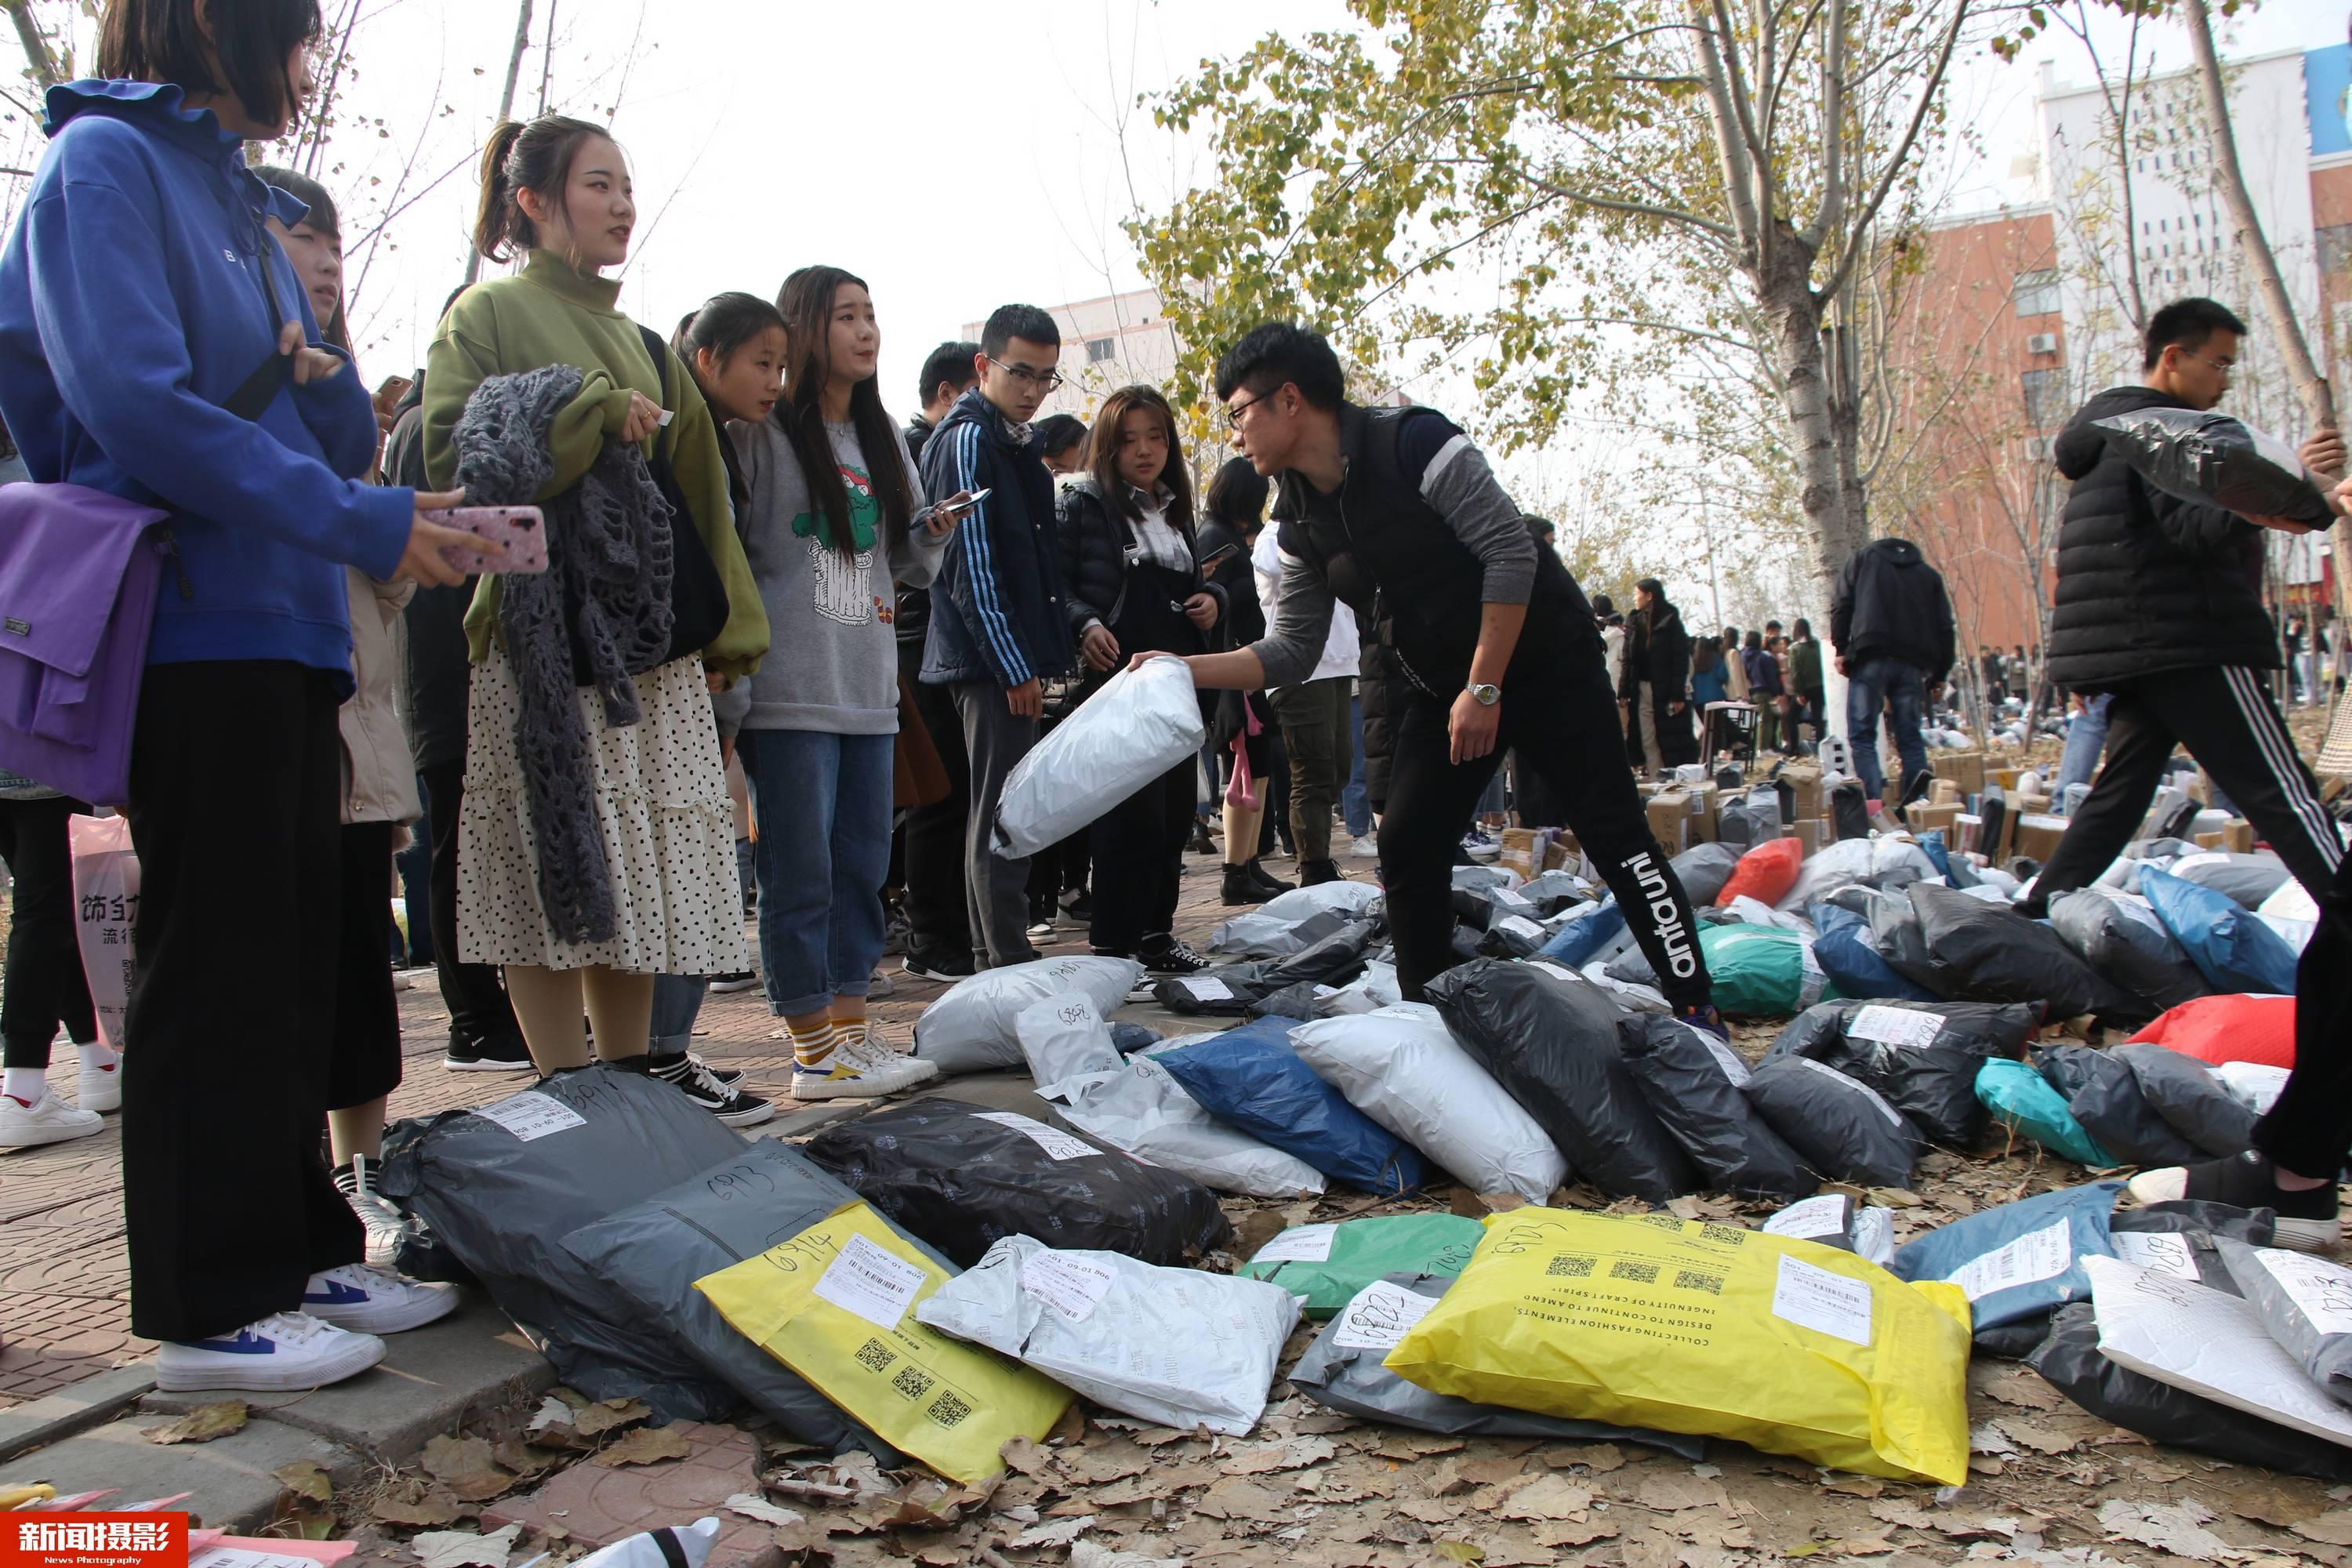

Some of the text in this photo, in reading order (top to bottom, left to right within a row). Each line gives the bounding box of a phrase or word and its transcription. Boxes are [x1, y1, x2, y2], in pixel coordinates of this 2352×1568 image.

[1620, 851, 1697, 979] antauni
[707, 1165, 775, 1202] 6913
[1094, 1270, 1111, 1281] 806
[1523, 1294, 1566, 1308] AMEND
[1549, 1287, 1715, 1316] INGENUITY OF CRAFT SPIRIT
[1567, 1303, 1582, 1312] TO
[1585, 1305, 1646, 1322] CONTINUE
[1512, 1306, 1709, 1347] COLLECTING FASHION ELEMENTS,
[1668, 1319, 1712, 1330] DESIGN
